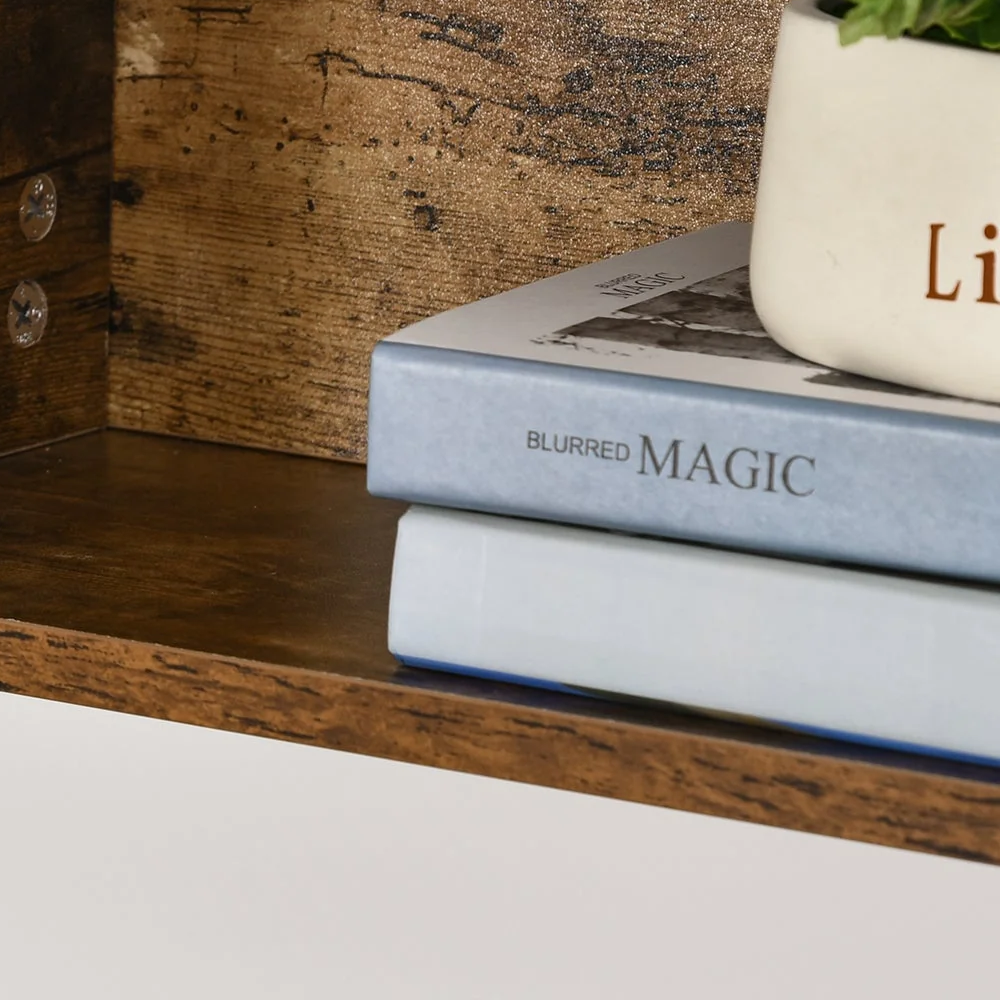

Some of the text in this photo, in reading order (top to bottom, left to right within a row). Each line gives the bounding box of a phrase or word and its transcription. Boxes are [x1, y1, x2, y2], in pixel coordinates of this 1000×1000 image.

[600, 271, 686, 299] MAGIC
[925, 223, 1000, 305] Li
[527, 430, 817, 497] BLURRED MAGIC
